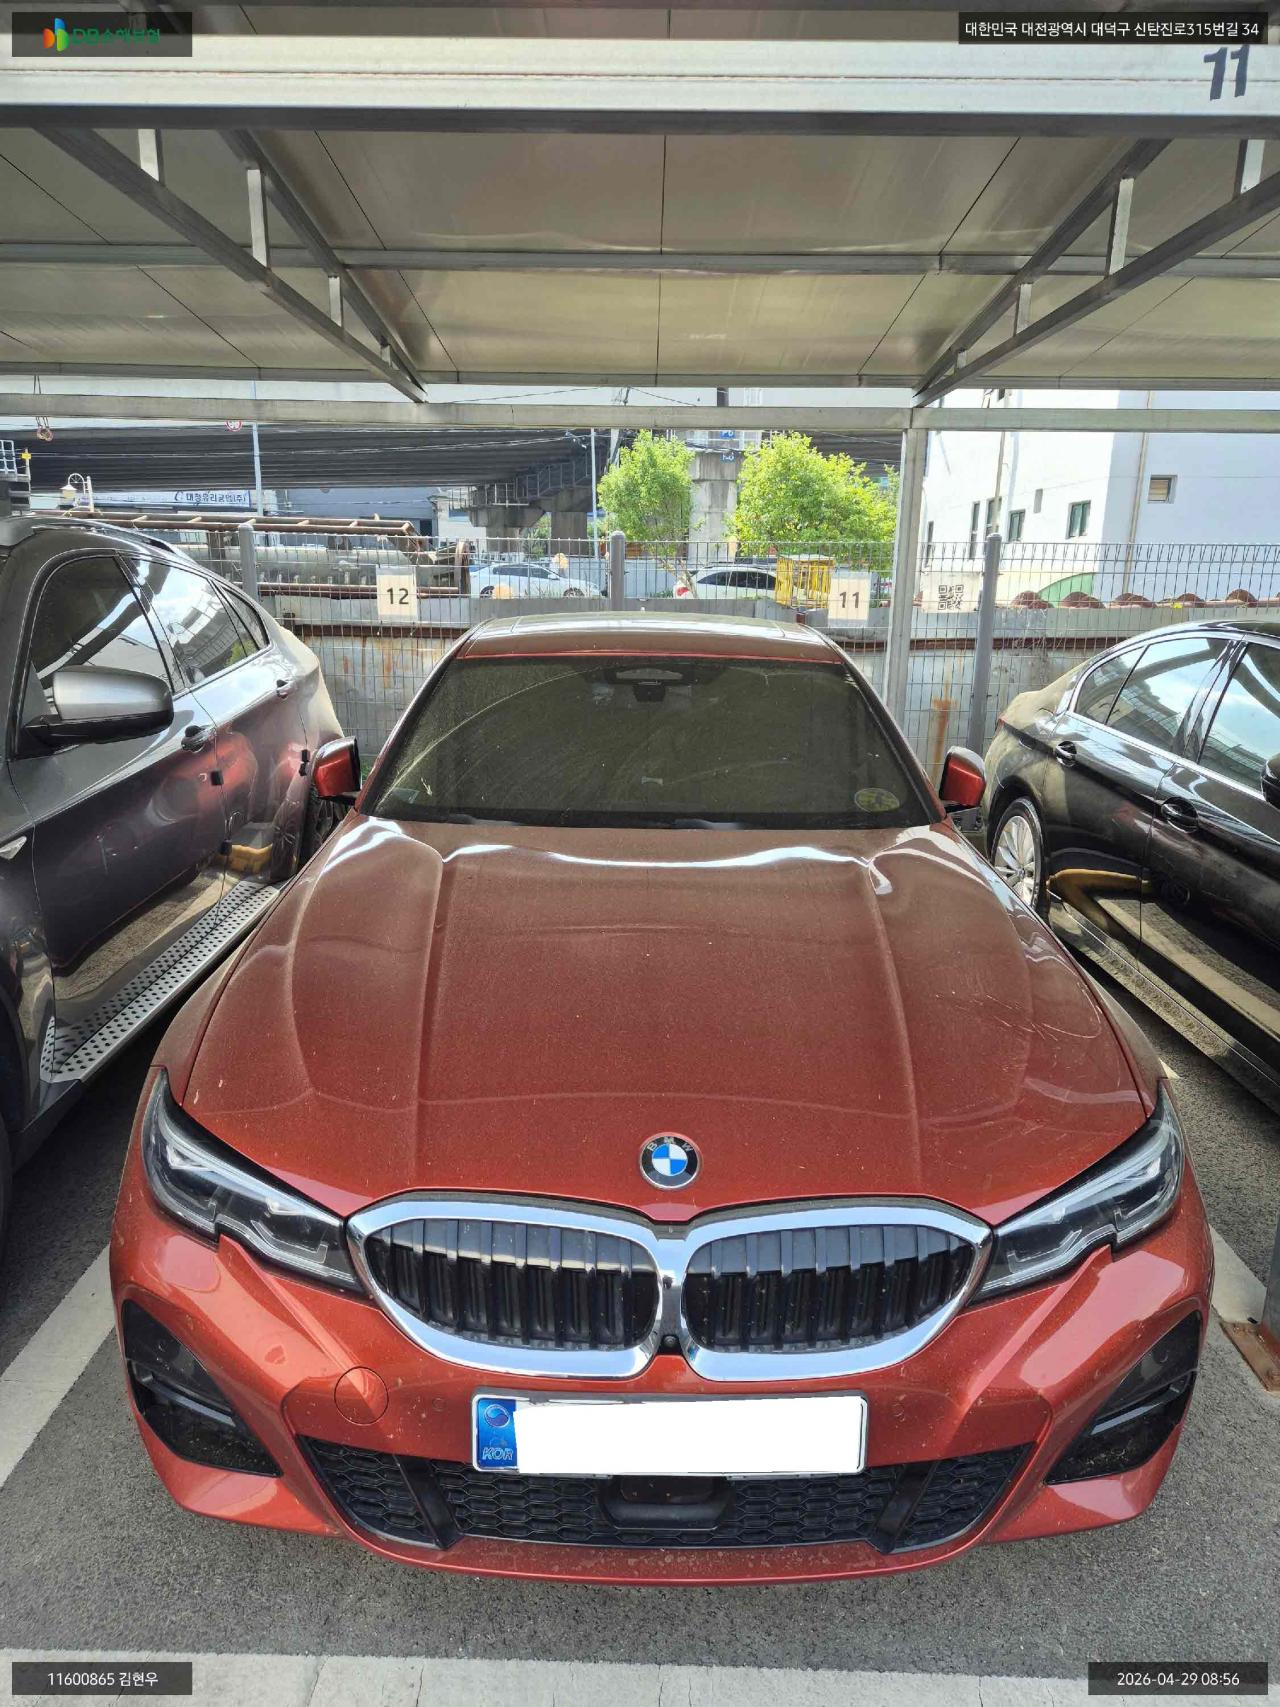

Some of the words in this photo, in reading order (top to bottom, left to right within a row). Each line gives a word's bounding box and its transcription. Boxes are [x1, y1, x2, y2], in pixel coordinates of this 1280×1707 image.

[1203, 44, 1250, 101] 11
[386, 587, 409, 605] 12
[839, 591, 860, 609] 11
[646, 1136, 694, 1152] BMW
[482, 1446, 514, 1461] KOR
